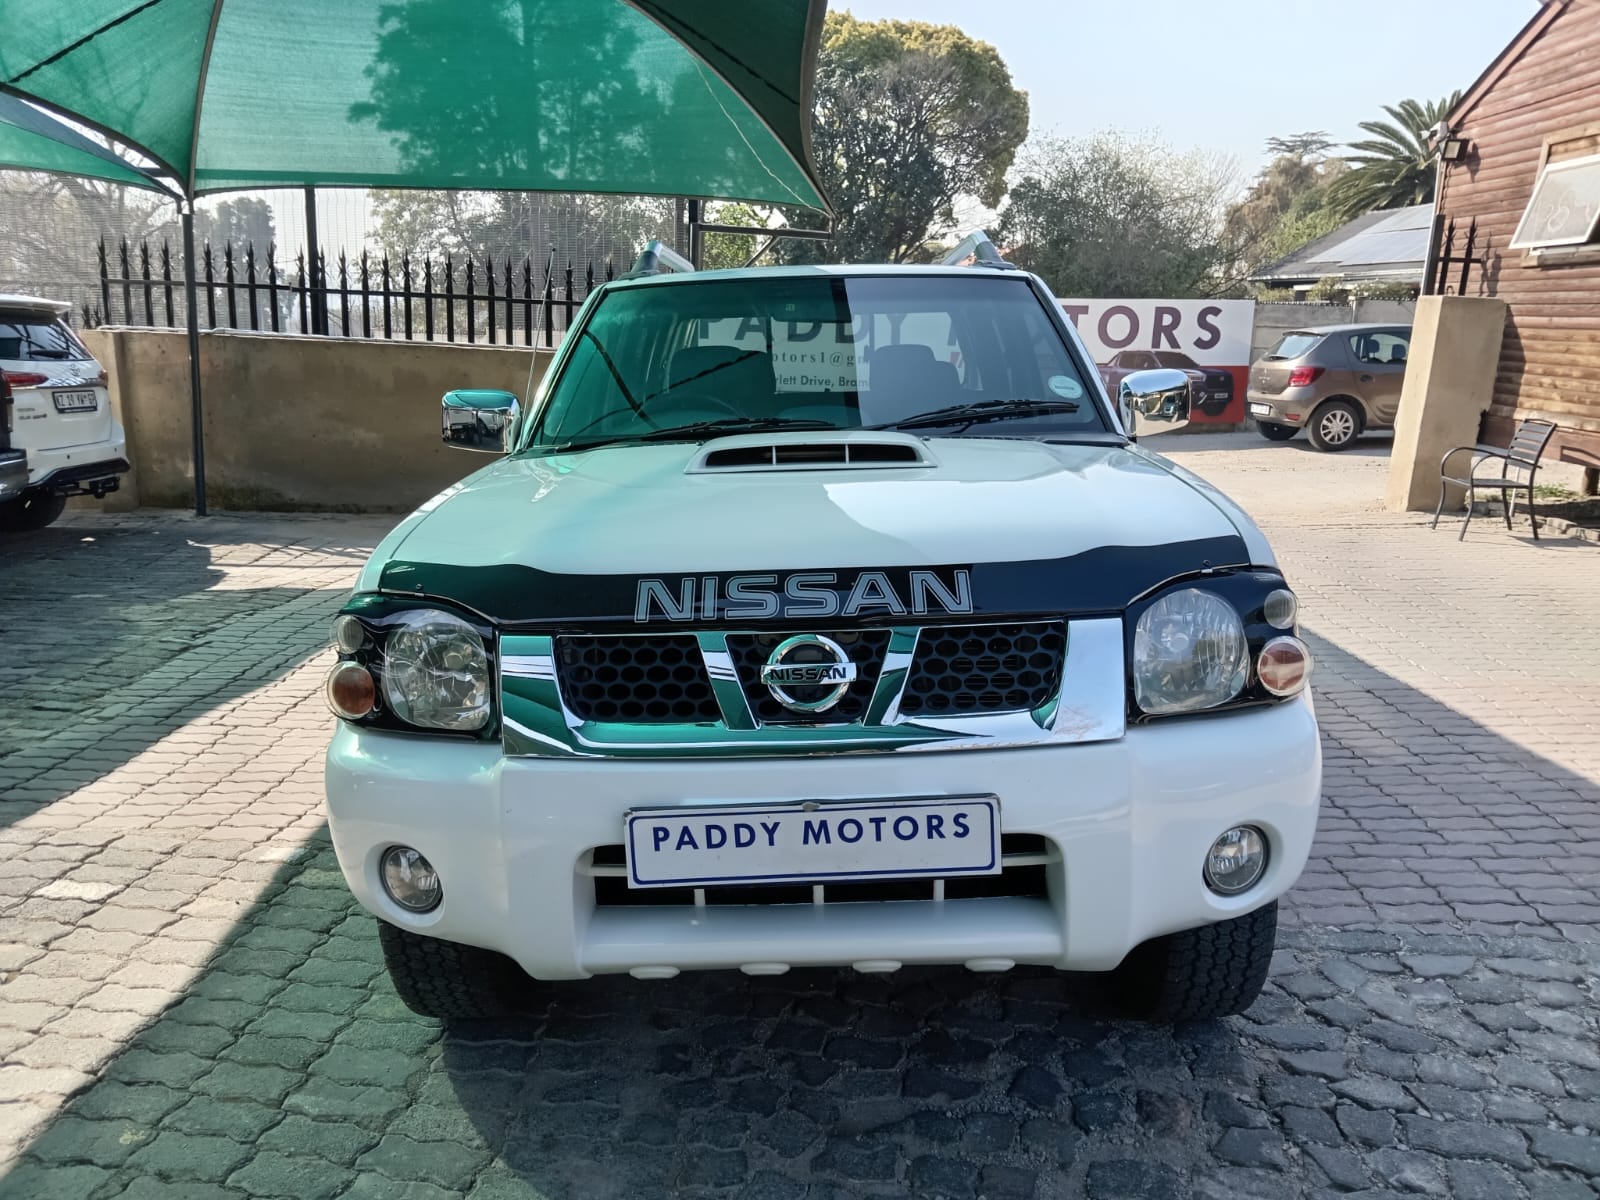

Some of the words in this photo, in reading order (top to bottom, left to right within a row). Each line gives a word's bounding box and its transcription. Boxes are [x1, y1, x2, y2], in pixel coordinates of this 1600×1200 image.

[801, 375, 834, 388] Drive,
[634, 570, 974, 623] NISSAN
[770, 667, 847, 681] NISSAN
[652, 821, 781, 852] PADDY
[802, 813, 971, 845] MOTORS
